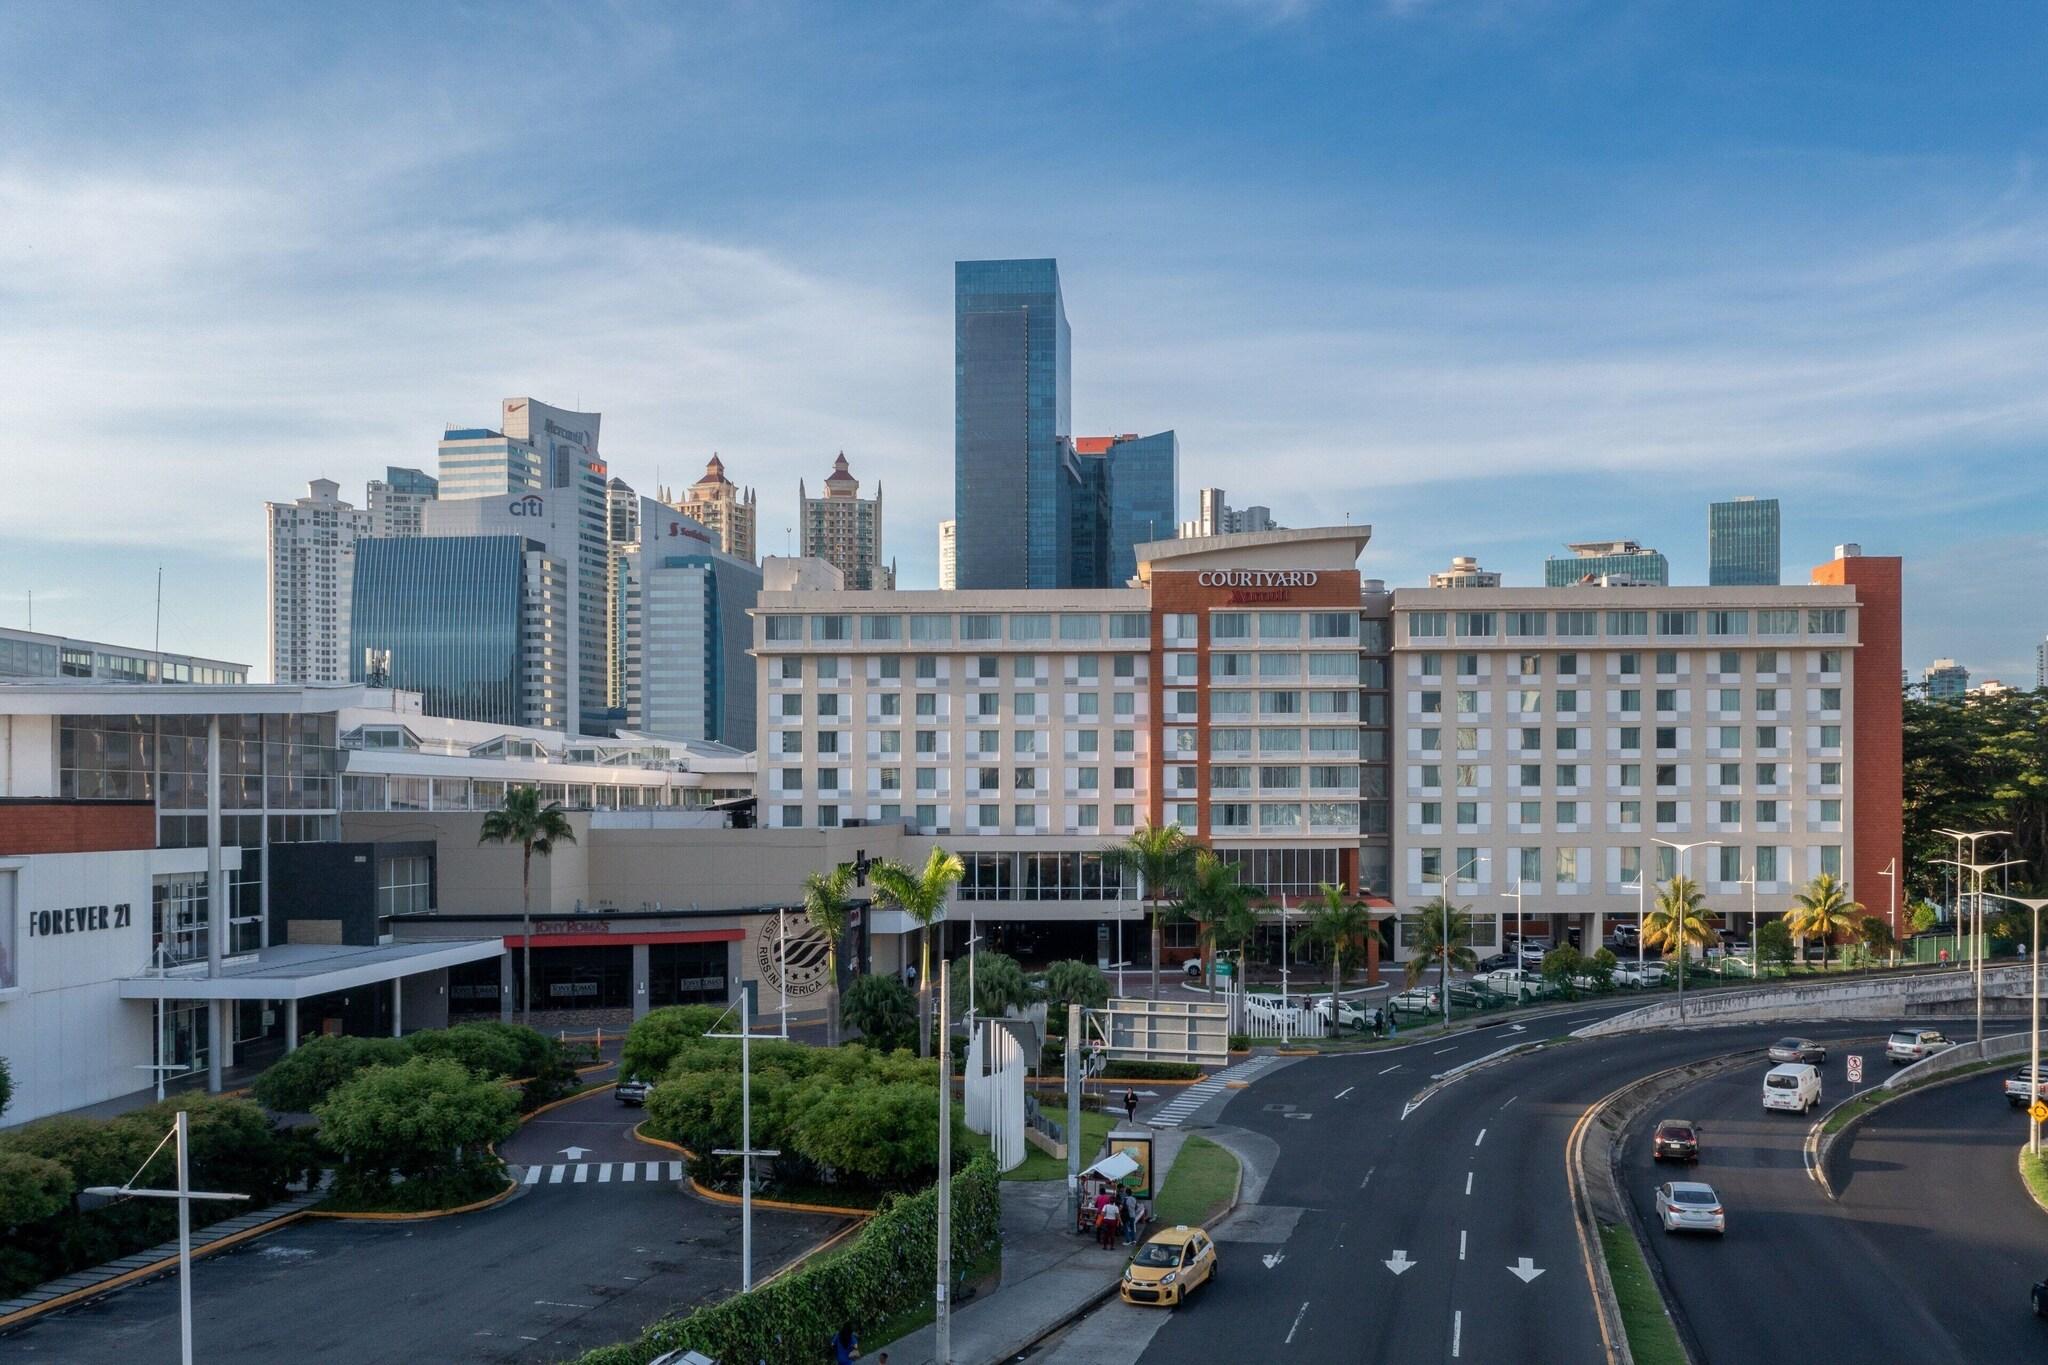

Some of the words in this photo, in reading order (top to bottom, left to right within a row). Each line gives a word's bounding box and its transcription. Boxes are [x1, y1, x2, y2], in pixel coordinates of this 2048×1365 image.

[509, 498, 543, 517] citi
[1198, 571, 1318, 587] COURTYARD
[29, 905, 109, 937] FOREVER
[114, 903, 131, 929] 21
[759, 946, 771, 973] RIBS
[768, 972, 779, 985] IN
